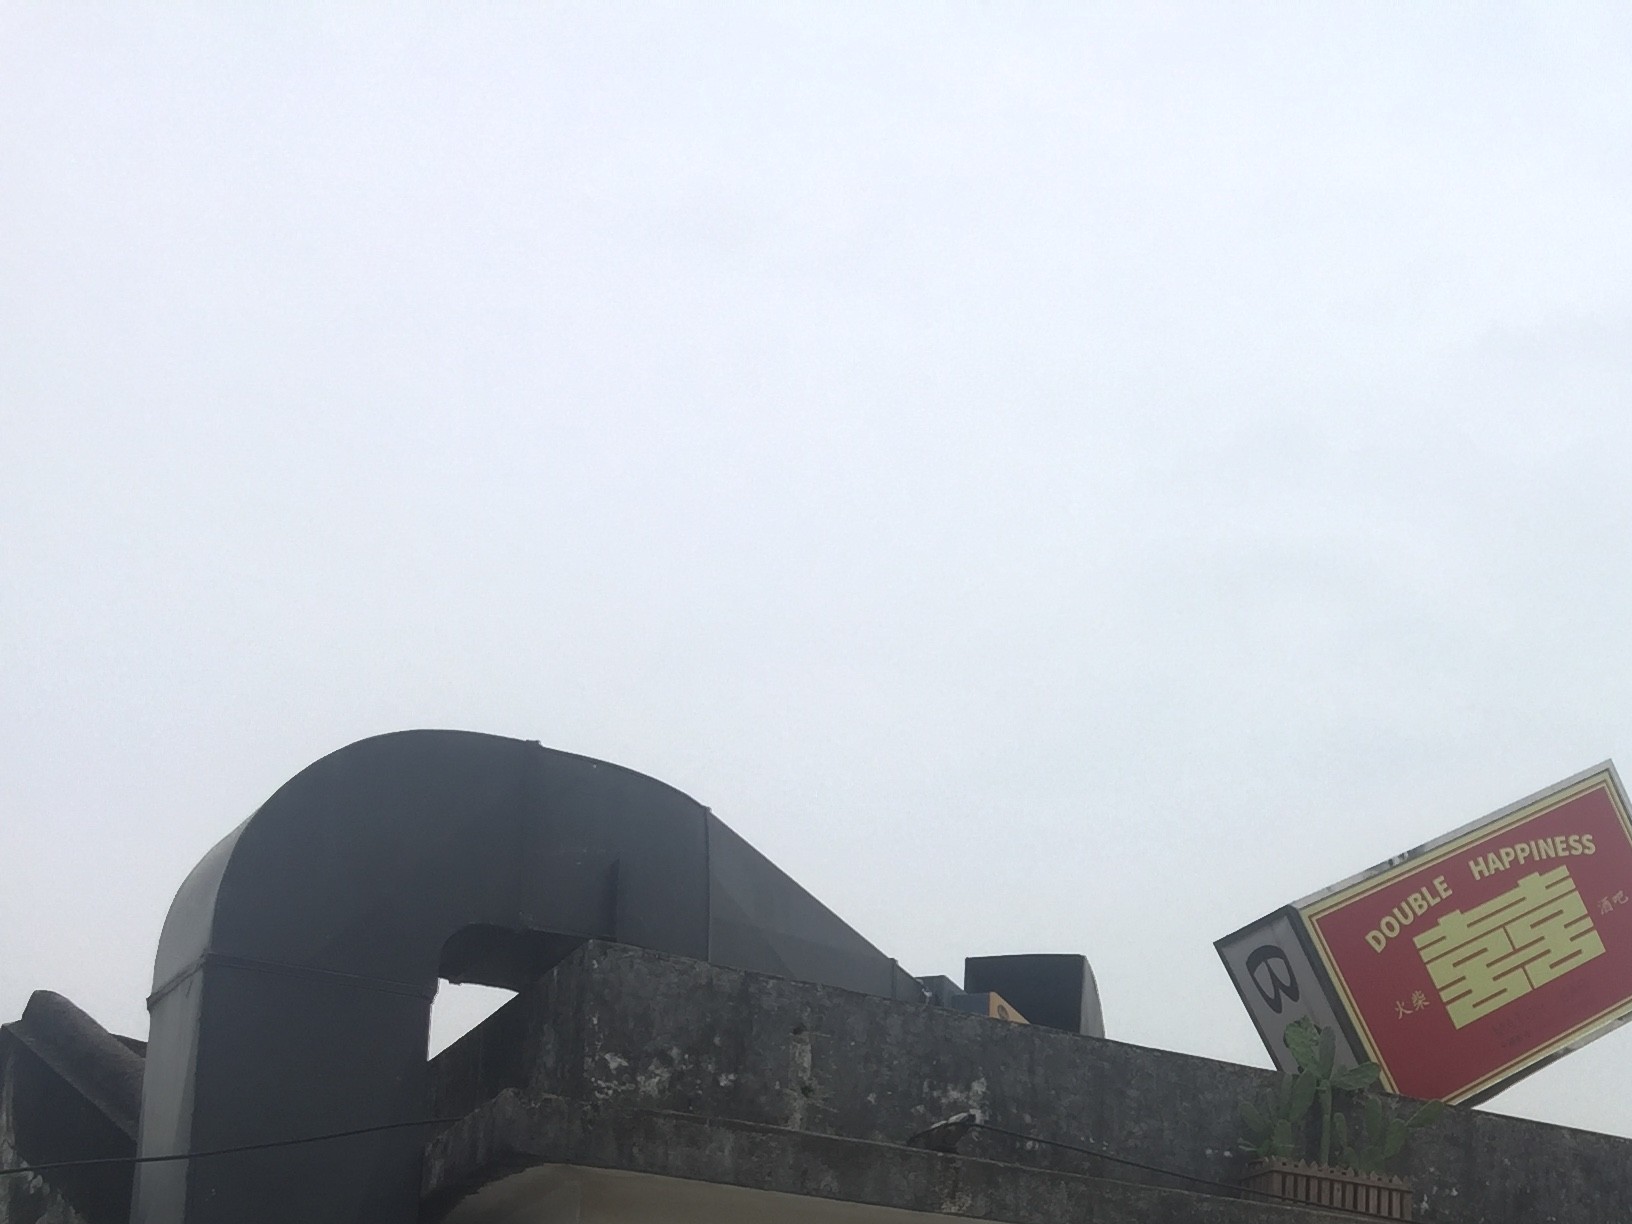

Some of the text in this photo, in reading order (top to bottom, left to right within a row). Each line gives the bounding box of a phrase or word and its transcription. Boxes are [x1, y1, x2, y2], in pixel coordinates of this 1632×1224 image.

[1365, 833, 1597, 953] DOUBLE HAPPINESS
[1597, 889, 1629, 916] 酒吧
[1394, 989, 1431, 1020] 火柴
